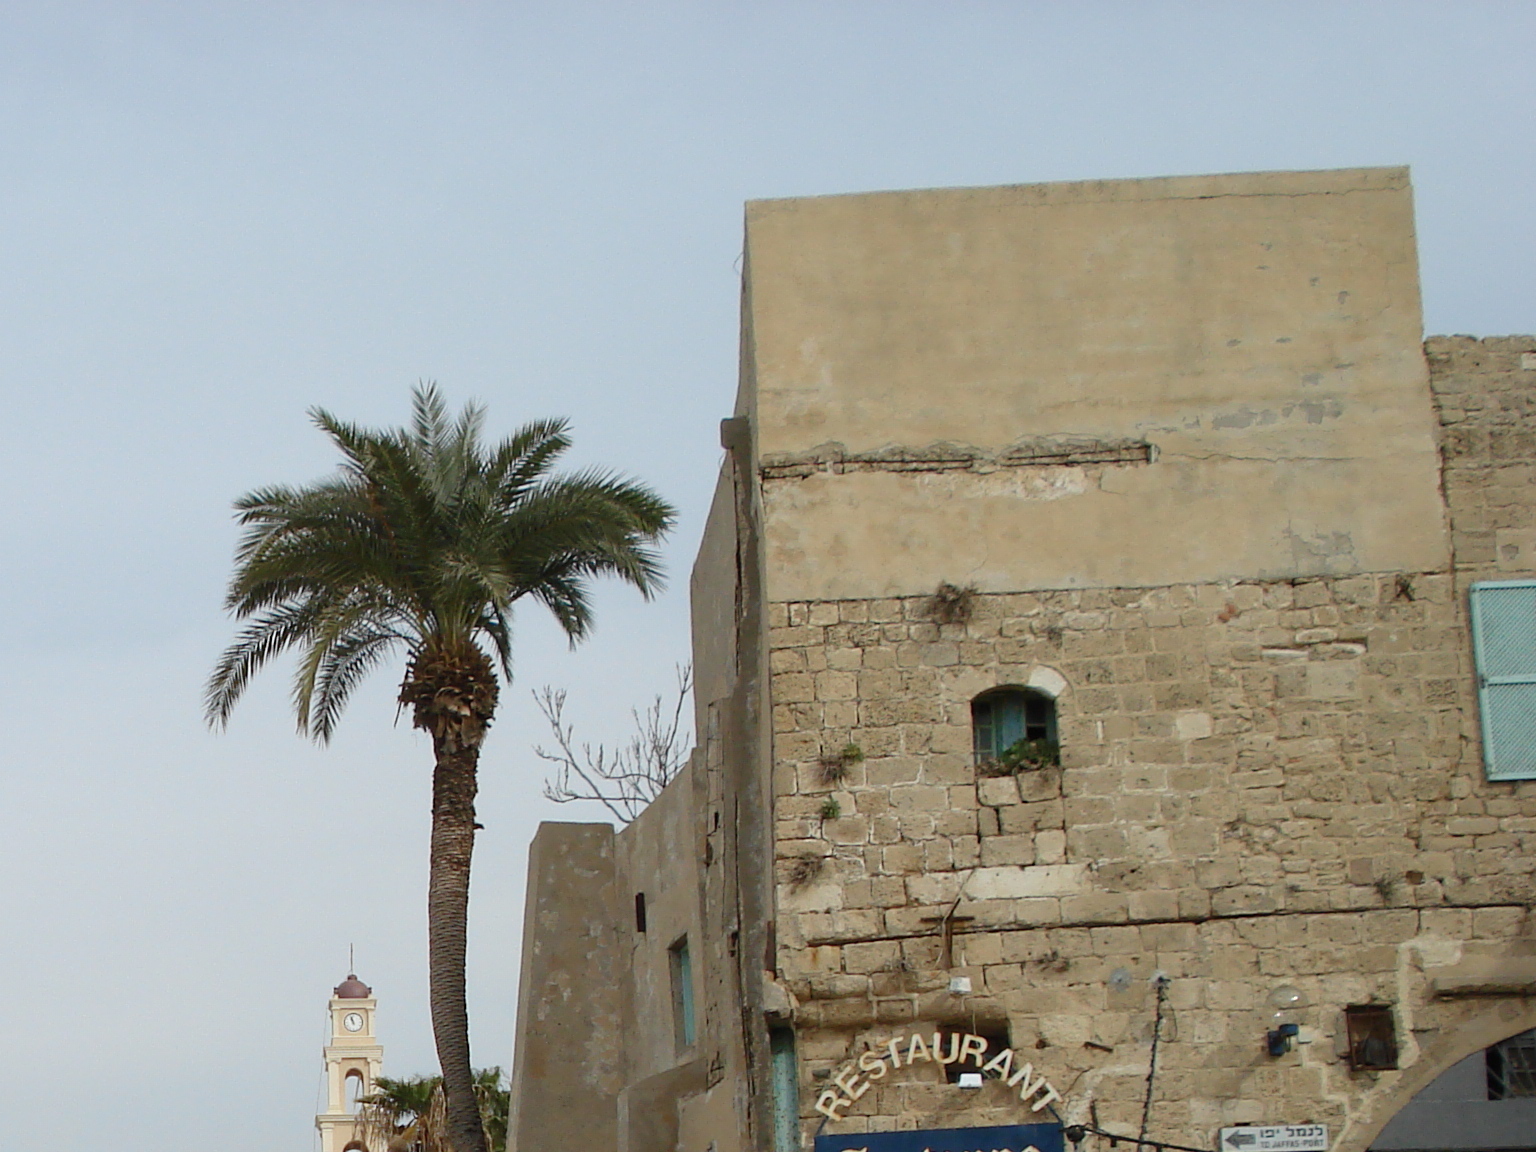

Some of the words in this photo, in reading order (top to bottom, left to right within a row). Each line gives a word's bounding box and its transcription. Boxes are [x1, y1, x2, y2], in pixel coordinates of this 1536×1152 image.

[815, 1032, 1063, 1121] RESTAURANT
[1260, 1129, 1280, 1138] יפו
[1285, 1125, 1323, 1137] לנמל
